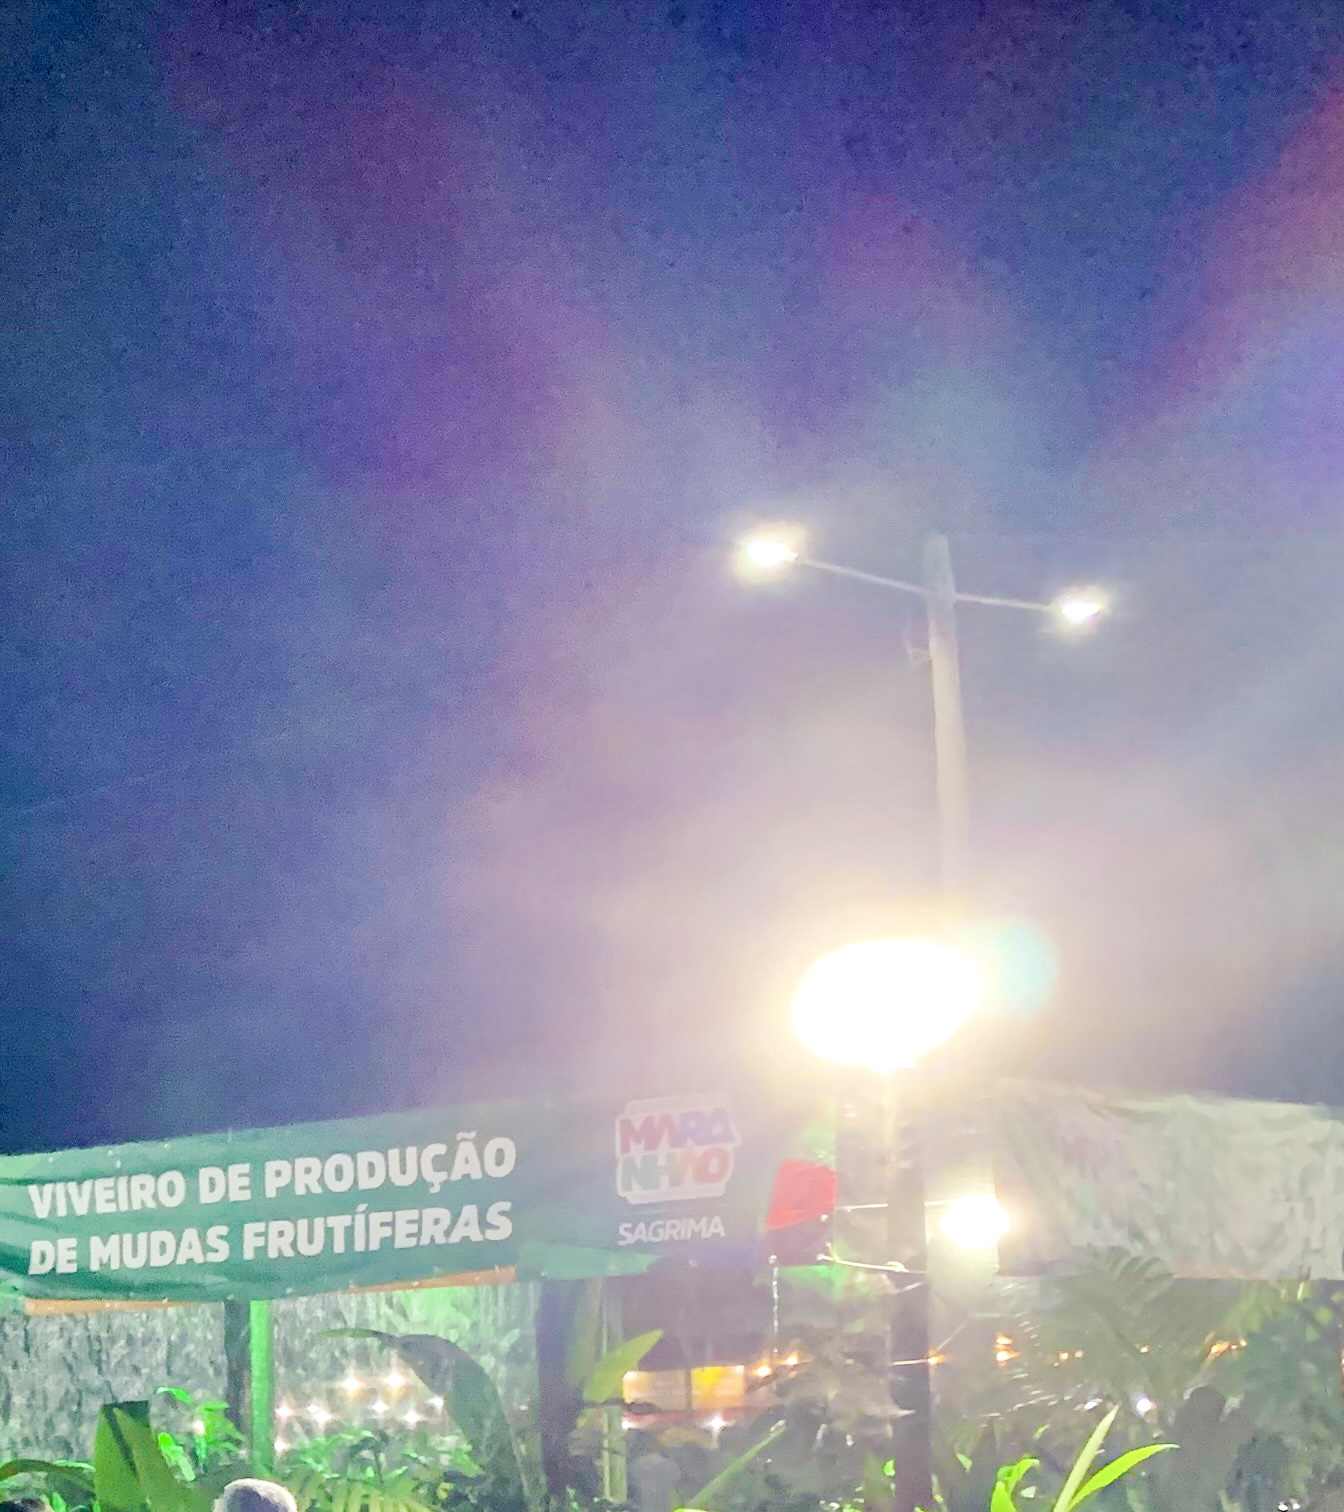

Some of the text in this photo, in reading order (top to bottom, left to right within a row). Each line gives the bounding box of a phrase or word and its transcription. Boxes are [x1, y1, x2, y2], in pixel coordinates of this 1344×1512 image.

[618, 1107, 737, 1154] MARA
[27, 1131, 517, 1219] VIVEIRO DE PRODUÇÃO
[27, 1202, 514, 1275] DE MUDAS FRUTÍFERAS
[616, 1214, 727, 1247] SAGRIMA
